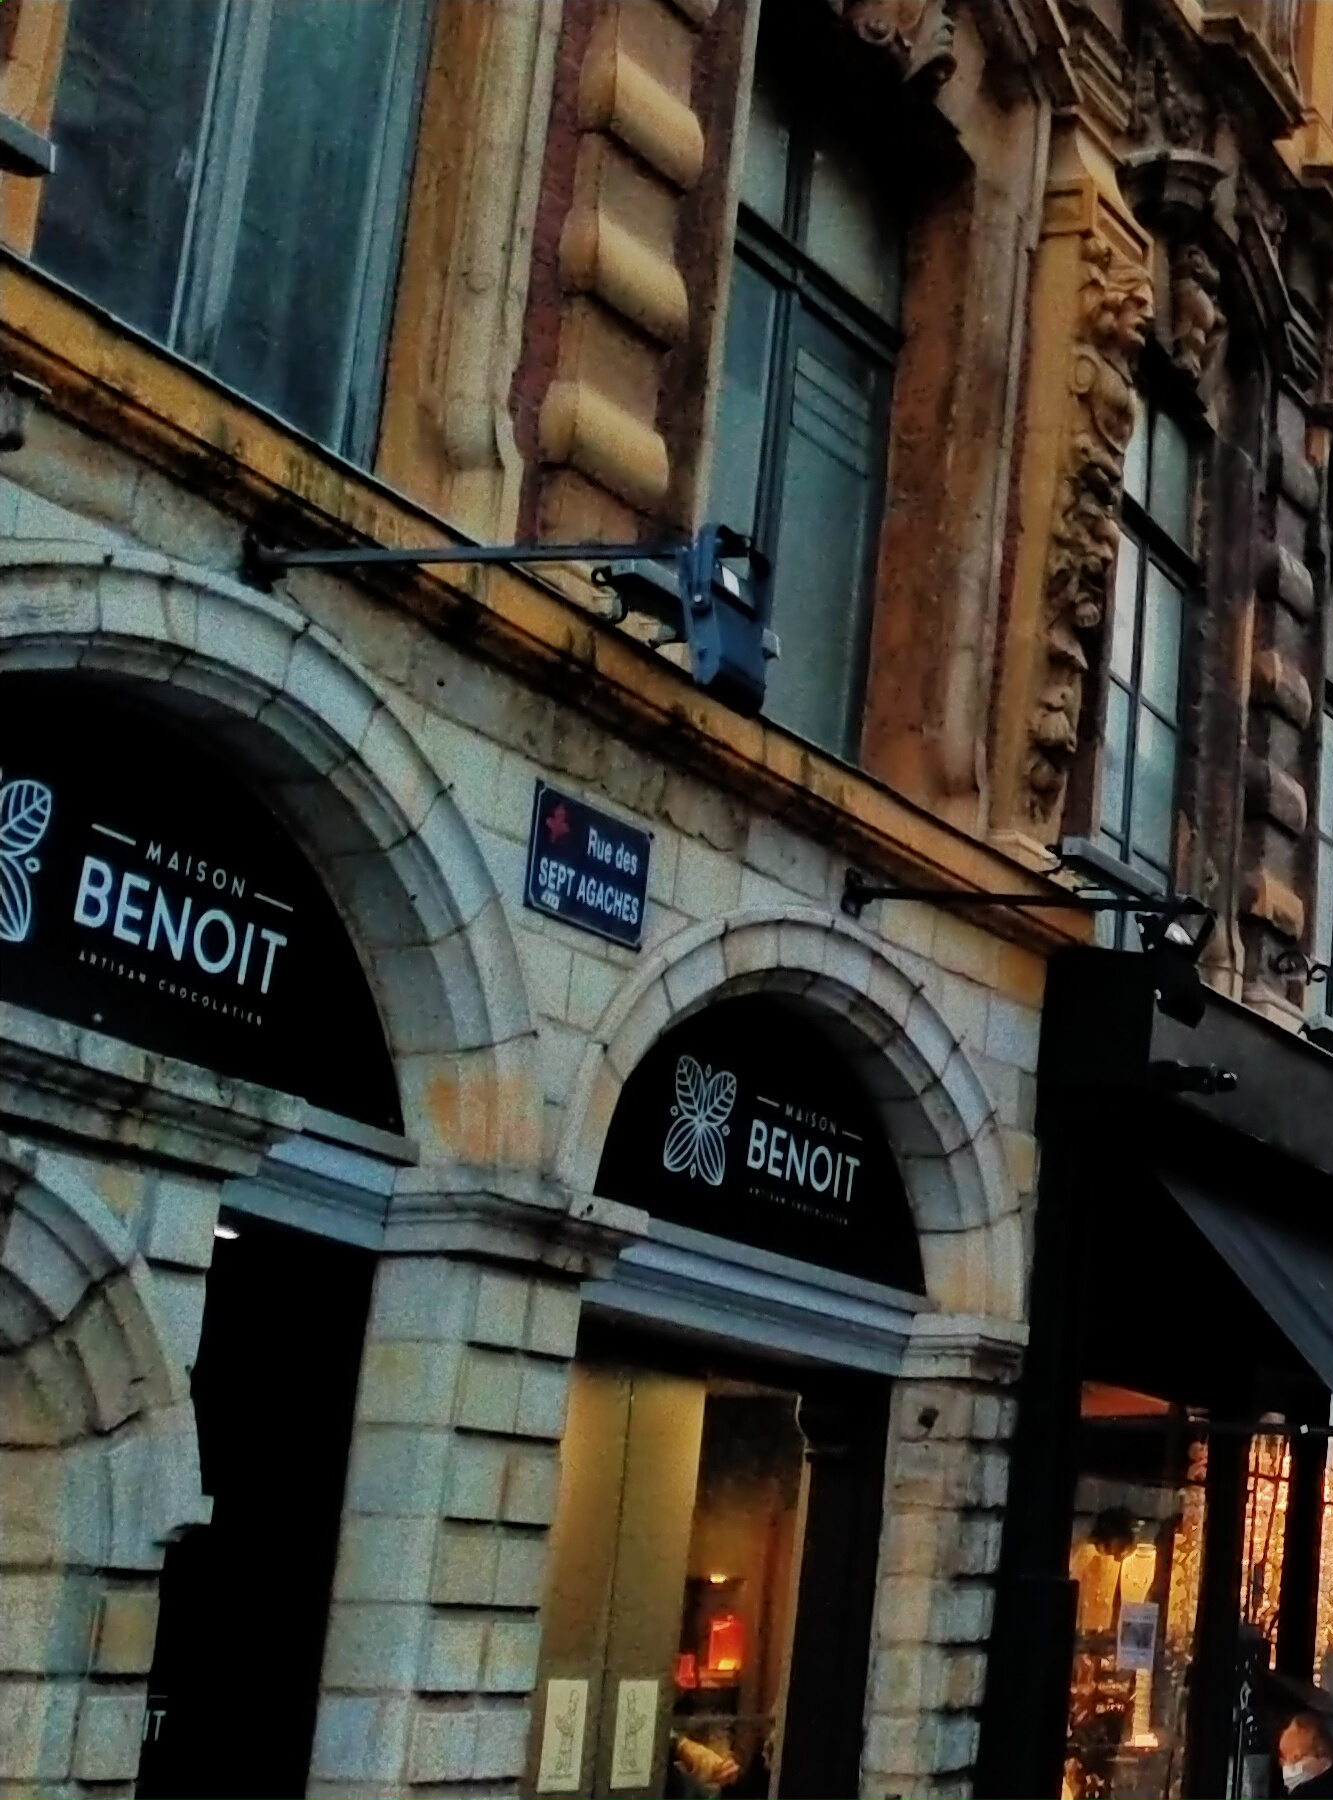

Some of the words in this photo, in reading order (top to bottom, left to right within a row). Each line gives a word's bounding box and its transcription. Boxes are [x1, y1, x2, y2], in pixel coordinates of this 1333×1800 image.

[145, 840, 247, 898] MAISON
[587, 826, 613, 864] Rue
[615, 842, 638, 876] des
[73, 855, 288, 994] BENOIT
[538, 856, 575, 897] SEPT
[576, 873, 640, 925] AGACHES
[78, 949, 147, 985] ARTISAN
[158, 978, 262, 1027] CHOCOLATIER
[785, 1103, 837, 1136] MAISON
[746, 1118, 861, 1202] BENOIT
